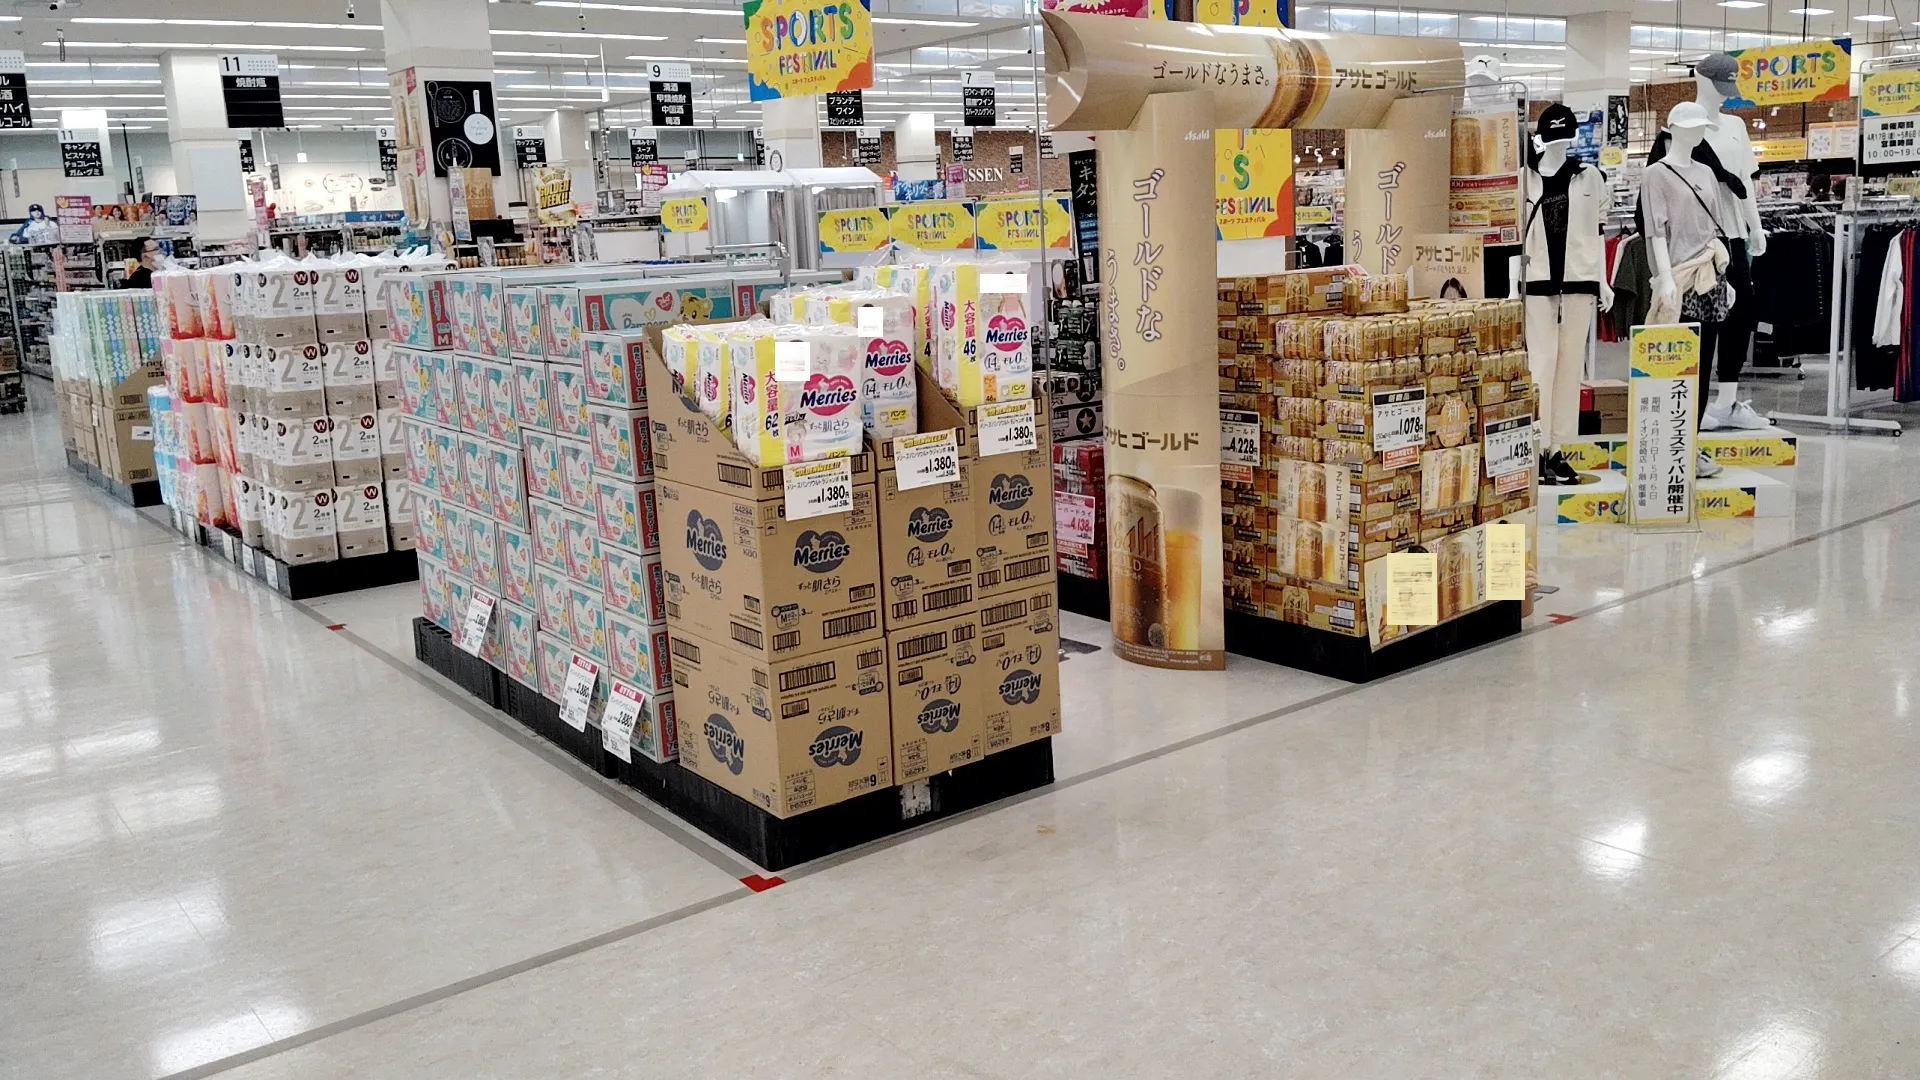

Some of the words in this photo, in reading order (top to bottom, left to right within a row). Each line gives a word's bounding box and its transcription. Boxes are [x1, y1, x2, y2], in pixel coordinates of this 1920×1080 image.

[761, 2, 854, 52] SPORTS
[222, 56, 241, 71] 11
[779, 49, 837, 75] FESTIVAL
[1740, 50, 1836, 81] SPORTS
[652, 64, 661, 78] 9
[965, 72, 972, 84] 7
[1152, 60, 1270, 87] ゴールドなうまさ。
[1335, 68, 1372, 88] アサヒ
[1375, 69, 1418, 91] ゴールド
[1756, 77, 1817, 93] FESTIVAL
[1868, 81, 1920, 97] SPORTS
[829, 96, 861, 105] ブランデー
[835, 106, 855, 115] ワイン
[61, 130, 74, 140] 11
[380, 128, 388, 138] 9
[517, 128, 524, 137] 8
[631, 128, 637, 137] 7
[756, 129, 762, 137] 6
[859, 129, 865, 137] 5
[1184, 129, 1210, 141] Asahi
[1423, 128, 1448, 139] Asahi
[64, 143, 97, 151] キャンディ
[64, 160, 101, 168] チョコレート
[69, 168, 101, 176] ガム・グミ
[539, 181, 571, 199] GOLDEN
[539, 193, 570, 210] WEEK!!
[834, 218, 875, 231] SPORTS
[907, 212, 955, 229] SPORTS
[997, 209, 1049, 228] SPORTS
[1376, 161, 1407, 275] ゴールド
[842, 232, 868, 242] FESTIVAL
[917, 230, 947, 241] FESTIVAL
[1007, 229, 1040, 239] FESTIVAL
[1351, 230, 1363, 262] う
[1415, 246, 1442, 262] アサヒ
[1445, 245, 1480, 263] ゴールド
[1133, 168, 1166, 342] ゴールドな
[1106, 249, 1126, 371] うまさ。
[963, 300, 976, 338] 大容量
[438, 336, 450, 345] M
[986, 328, 1028, 344] Merries
[963, 340, 976, 356] 46
[1638, 341, 1693, 355] SPORTS
[331, 344, 348, 377] 2
[865, 350, 912, 369] Merries
[987, 357, 997, 367] 14
[705, 371, 715, 402] Merries
[741, 372, 750, 405] Merries
[766, 371, 779, 411] 大容量
[865, 384, 876, 396] 14
[1011, 384, 1026, 393] パンツ
[800, 388, 857, 409] Merries
[863, 404, 871, 415] L
[890, 410, 906, 418] パンツ
[1377, 406, 1422, 418] アサヒゴールド
[1445, 396, 1461, 421] 新
[315, 421, 325, 431] W
[362, 417, 372, 426] W
[766, 413, 779, 430] 62
[809, 416, 850, 432] ずっと肌さら
[1399, 417, 1424, 436] 1,078円
[289, 424, 307, 457] 2
[337, 419, 355, 452] 2
[1131, 431, 1199, 451] ゴールド
[1488, 432, 1529, 446] アサヒゴールド
[790, 445, 800, 457] M
[1230, 437, 1258, 456] 4,228円
[1509, 441, 1532, 460] 1,428円
[1667, 379, 1688, 515] スポーツフェスティバル開催中
[1714, 446, 1773, 459] FESTIVAL
[317, 495, 328, 504] W
[366, 487, 377, 497] W
[988, 485, 1034, 504] Merries
[1335, 470, 1343, 520] アサヒゴールド
[290, 497, 308, 530] 2
[340, 490, 358, 523] 2
[777, 504, 785, 518] 6
[908, 518, 953, 537] Merries
[686, 527, 727, 561] Merries
[793, 543, 851, 567] Merries
[1476, 530, 1484, 600] アサヒゴールド
[798, 576, 841, 592] ずっと肌さら
[998, 674, 1042, 696] Merries
[917, 702, 961, 724] Merries
[703, 721, 745, 759] Merries
[808, 730, 864, 757] Merries
